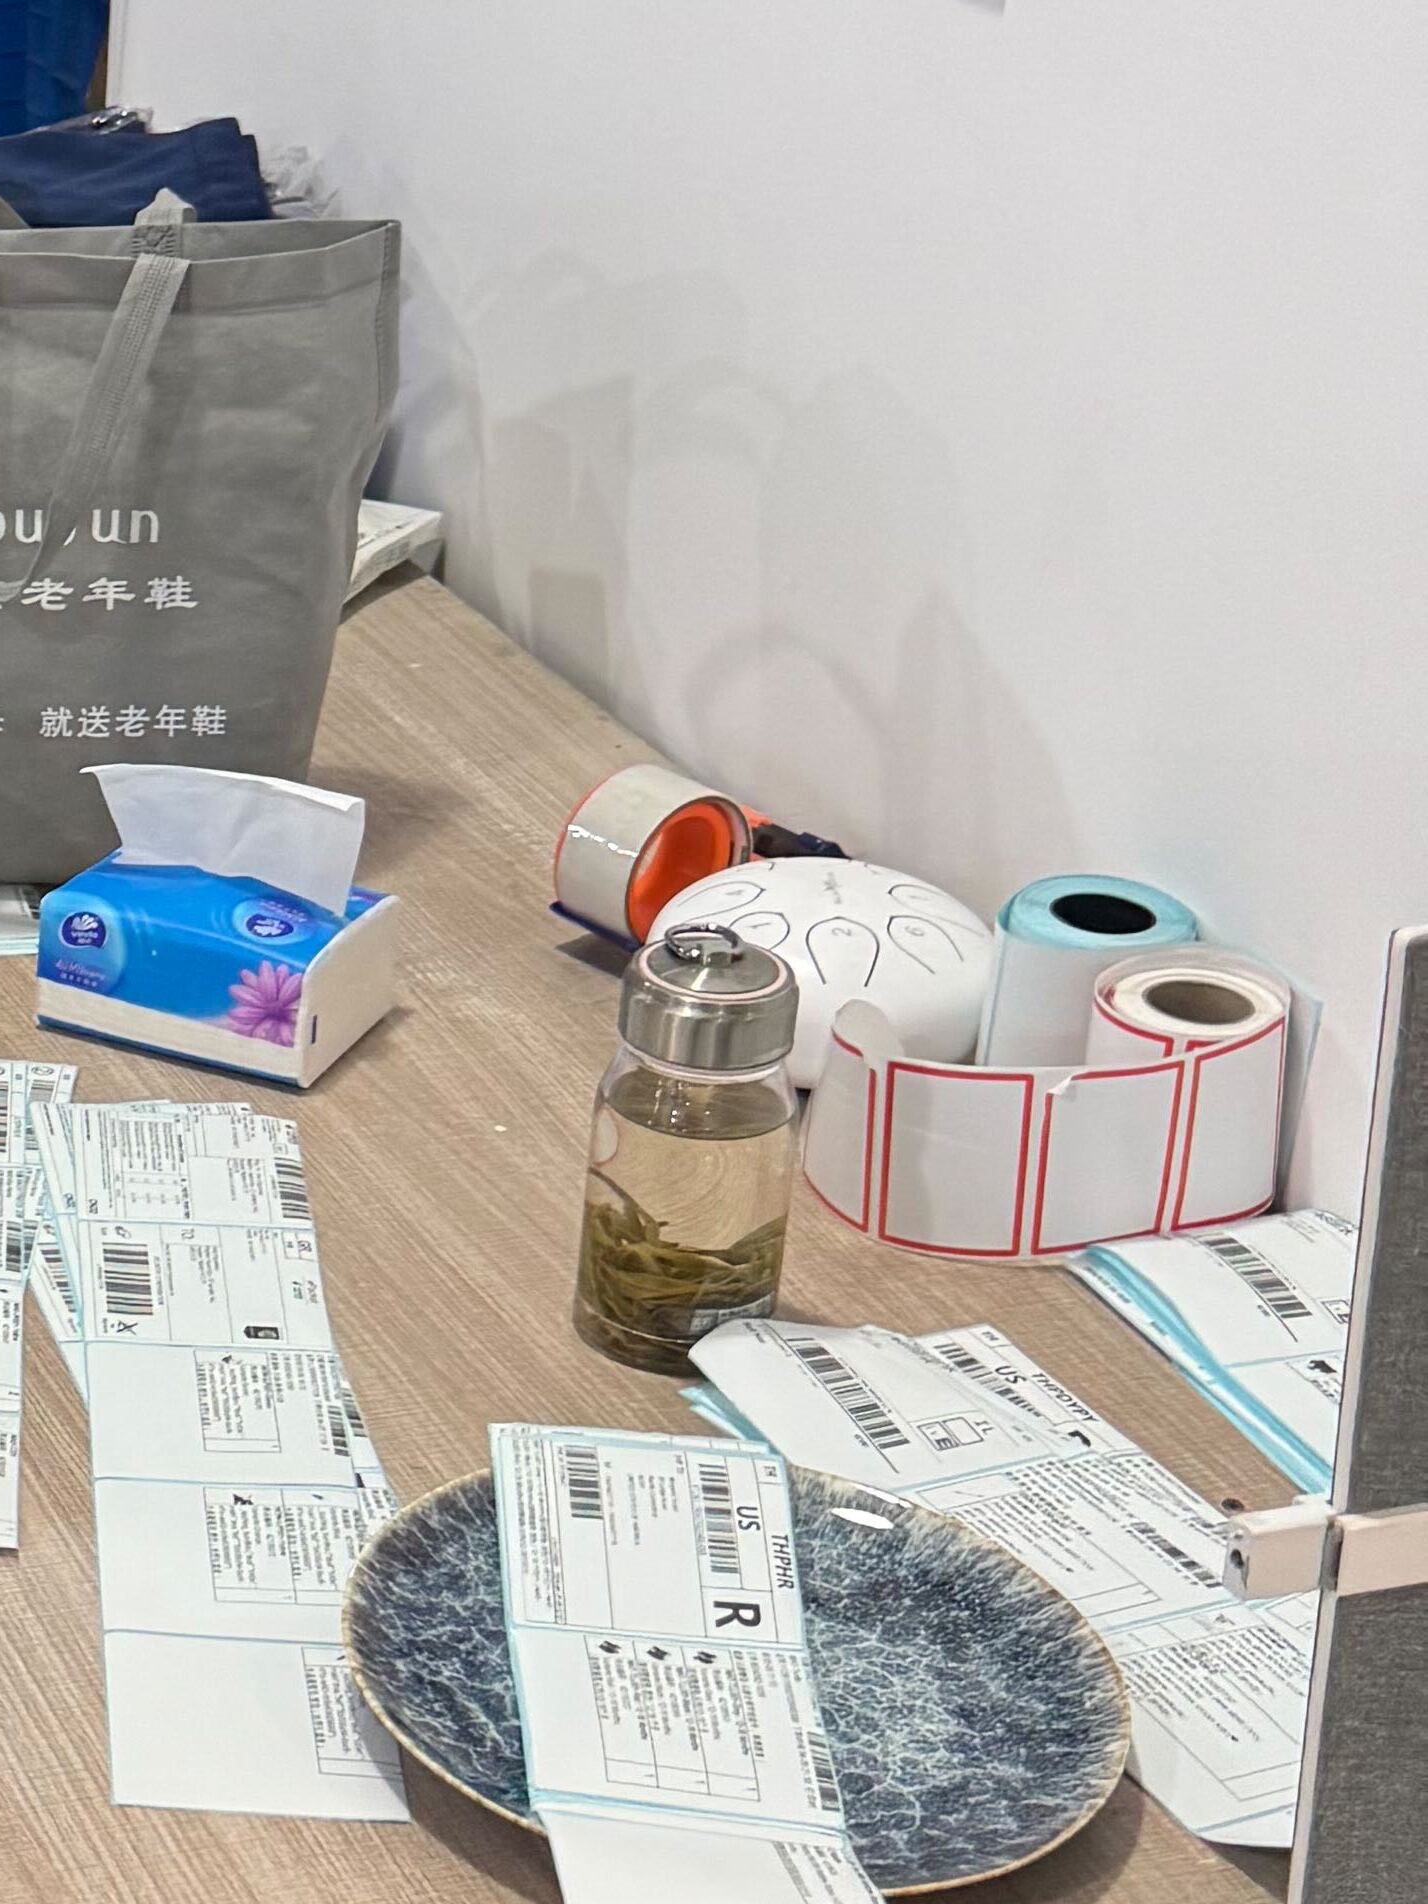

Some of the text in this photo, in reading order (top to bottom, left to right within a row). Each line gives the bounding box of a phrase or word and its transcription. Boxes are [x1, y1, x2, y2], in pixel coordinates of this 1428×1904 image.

[39, 704, 228, 739] 就送老年鞋
[995, 1364, 1028, 1384] US
[736, 1505, 762, 1532] US
[771, 1533, 794, 1590] THPHR
[712, 1600, 763, 1628] R
